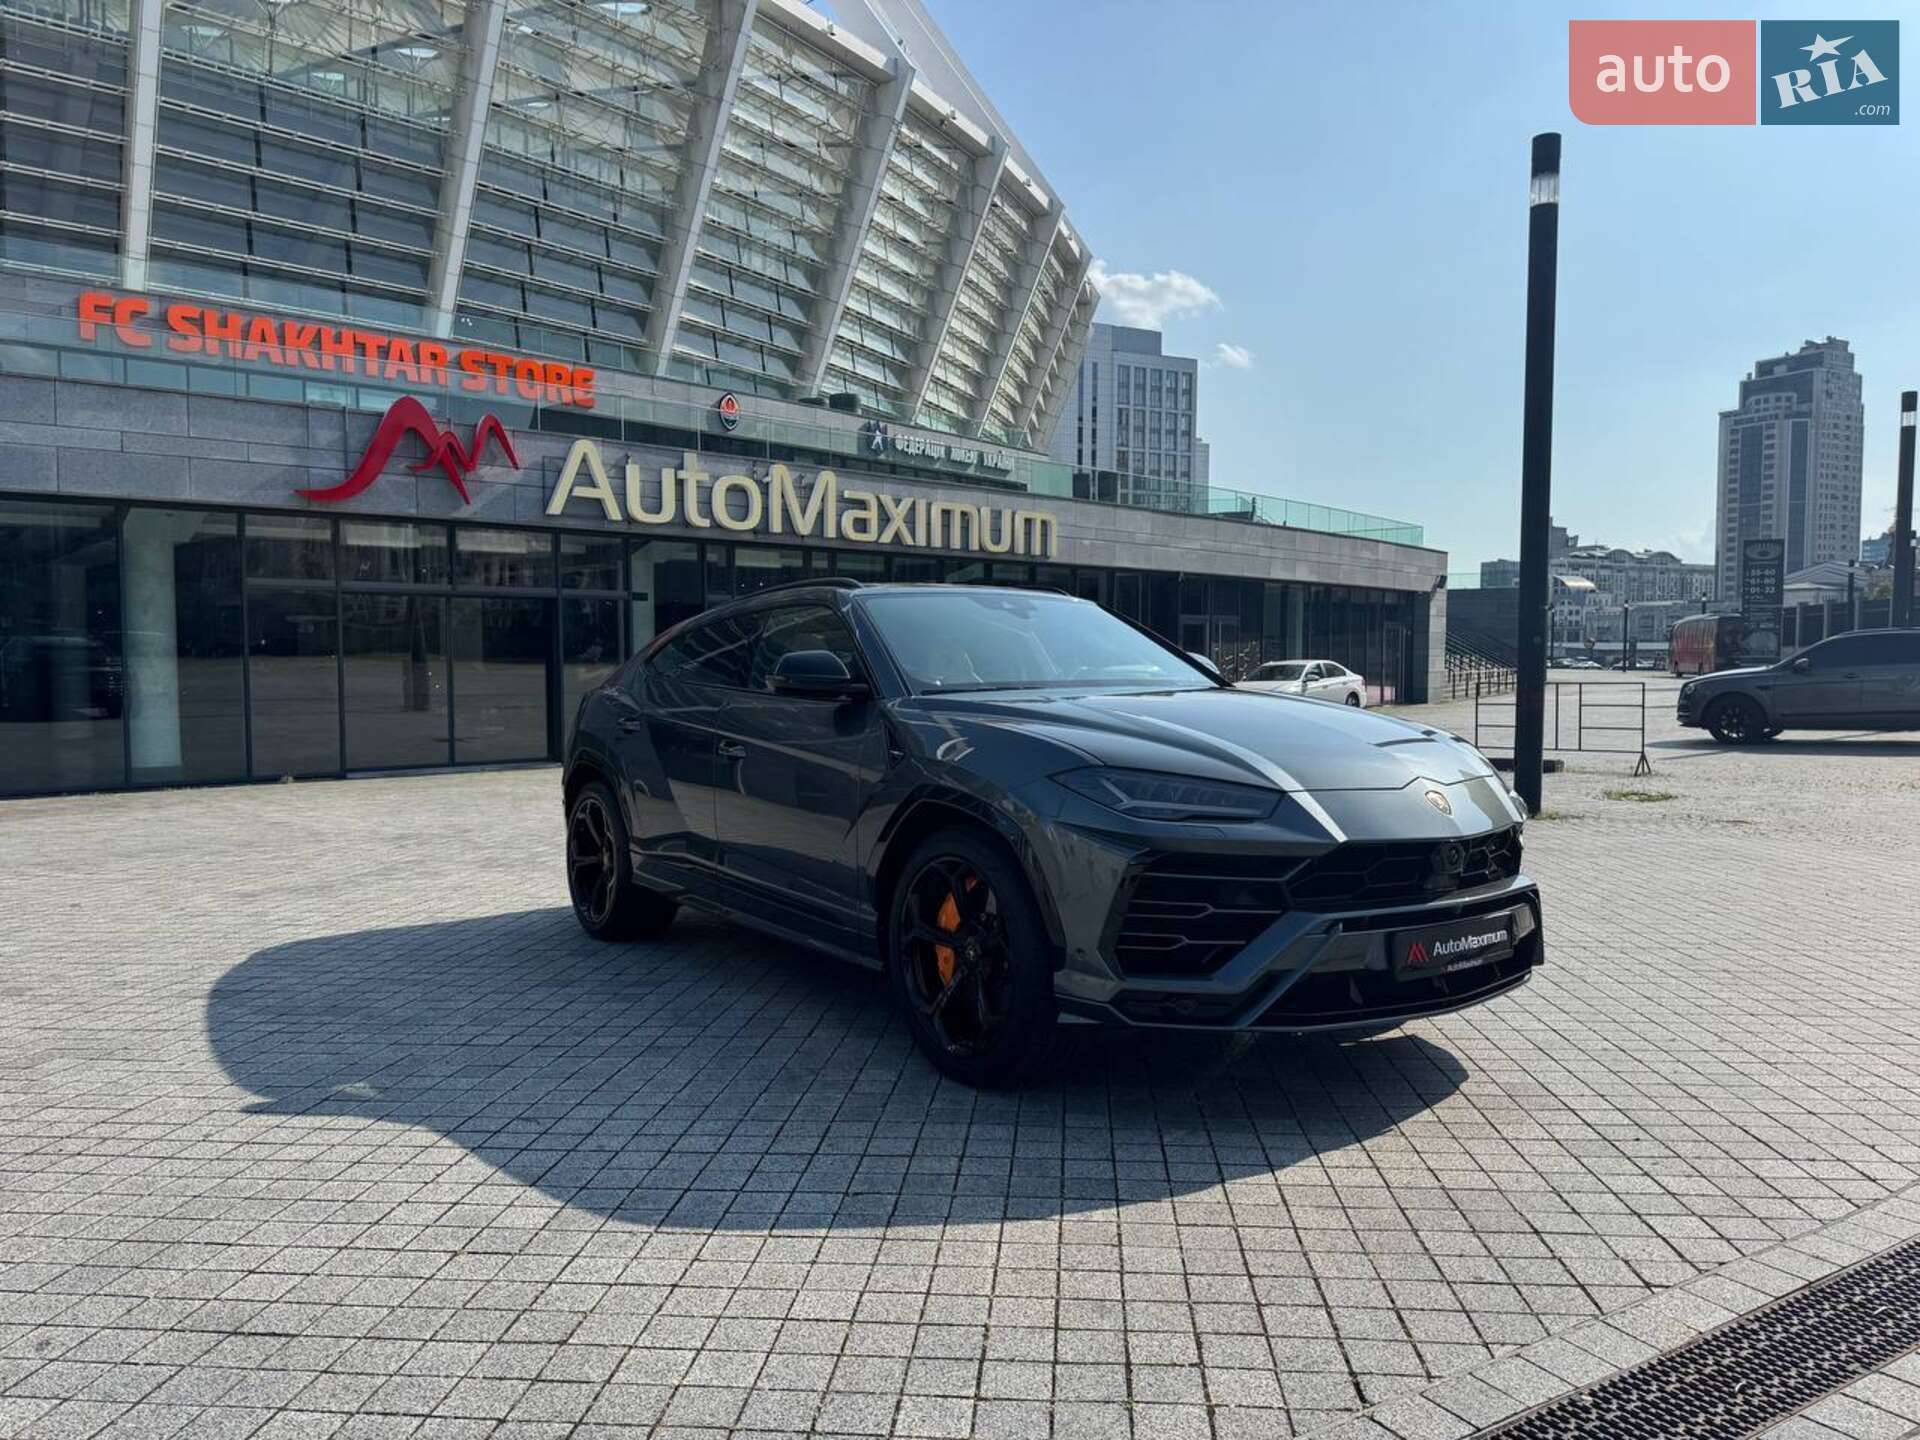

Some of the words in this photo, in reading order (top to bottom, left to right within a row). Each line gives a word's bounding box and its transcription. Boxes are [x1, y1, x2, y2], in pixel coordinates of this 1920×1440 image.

[77, 291, 152, 347] FC
[165, 303, 449, 386] SHAKHTAR
[457, 349, 596, 409] STORE
[545, 438, 1059, 560] AutoMaximum
[1433, 929, 1508, 957] AutoMaximum
